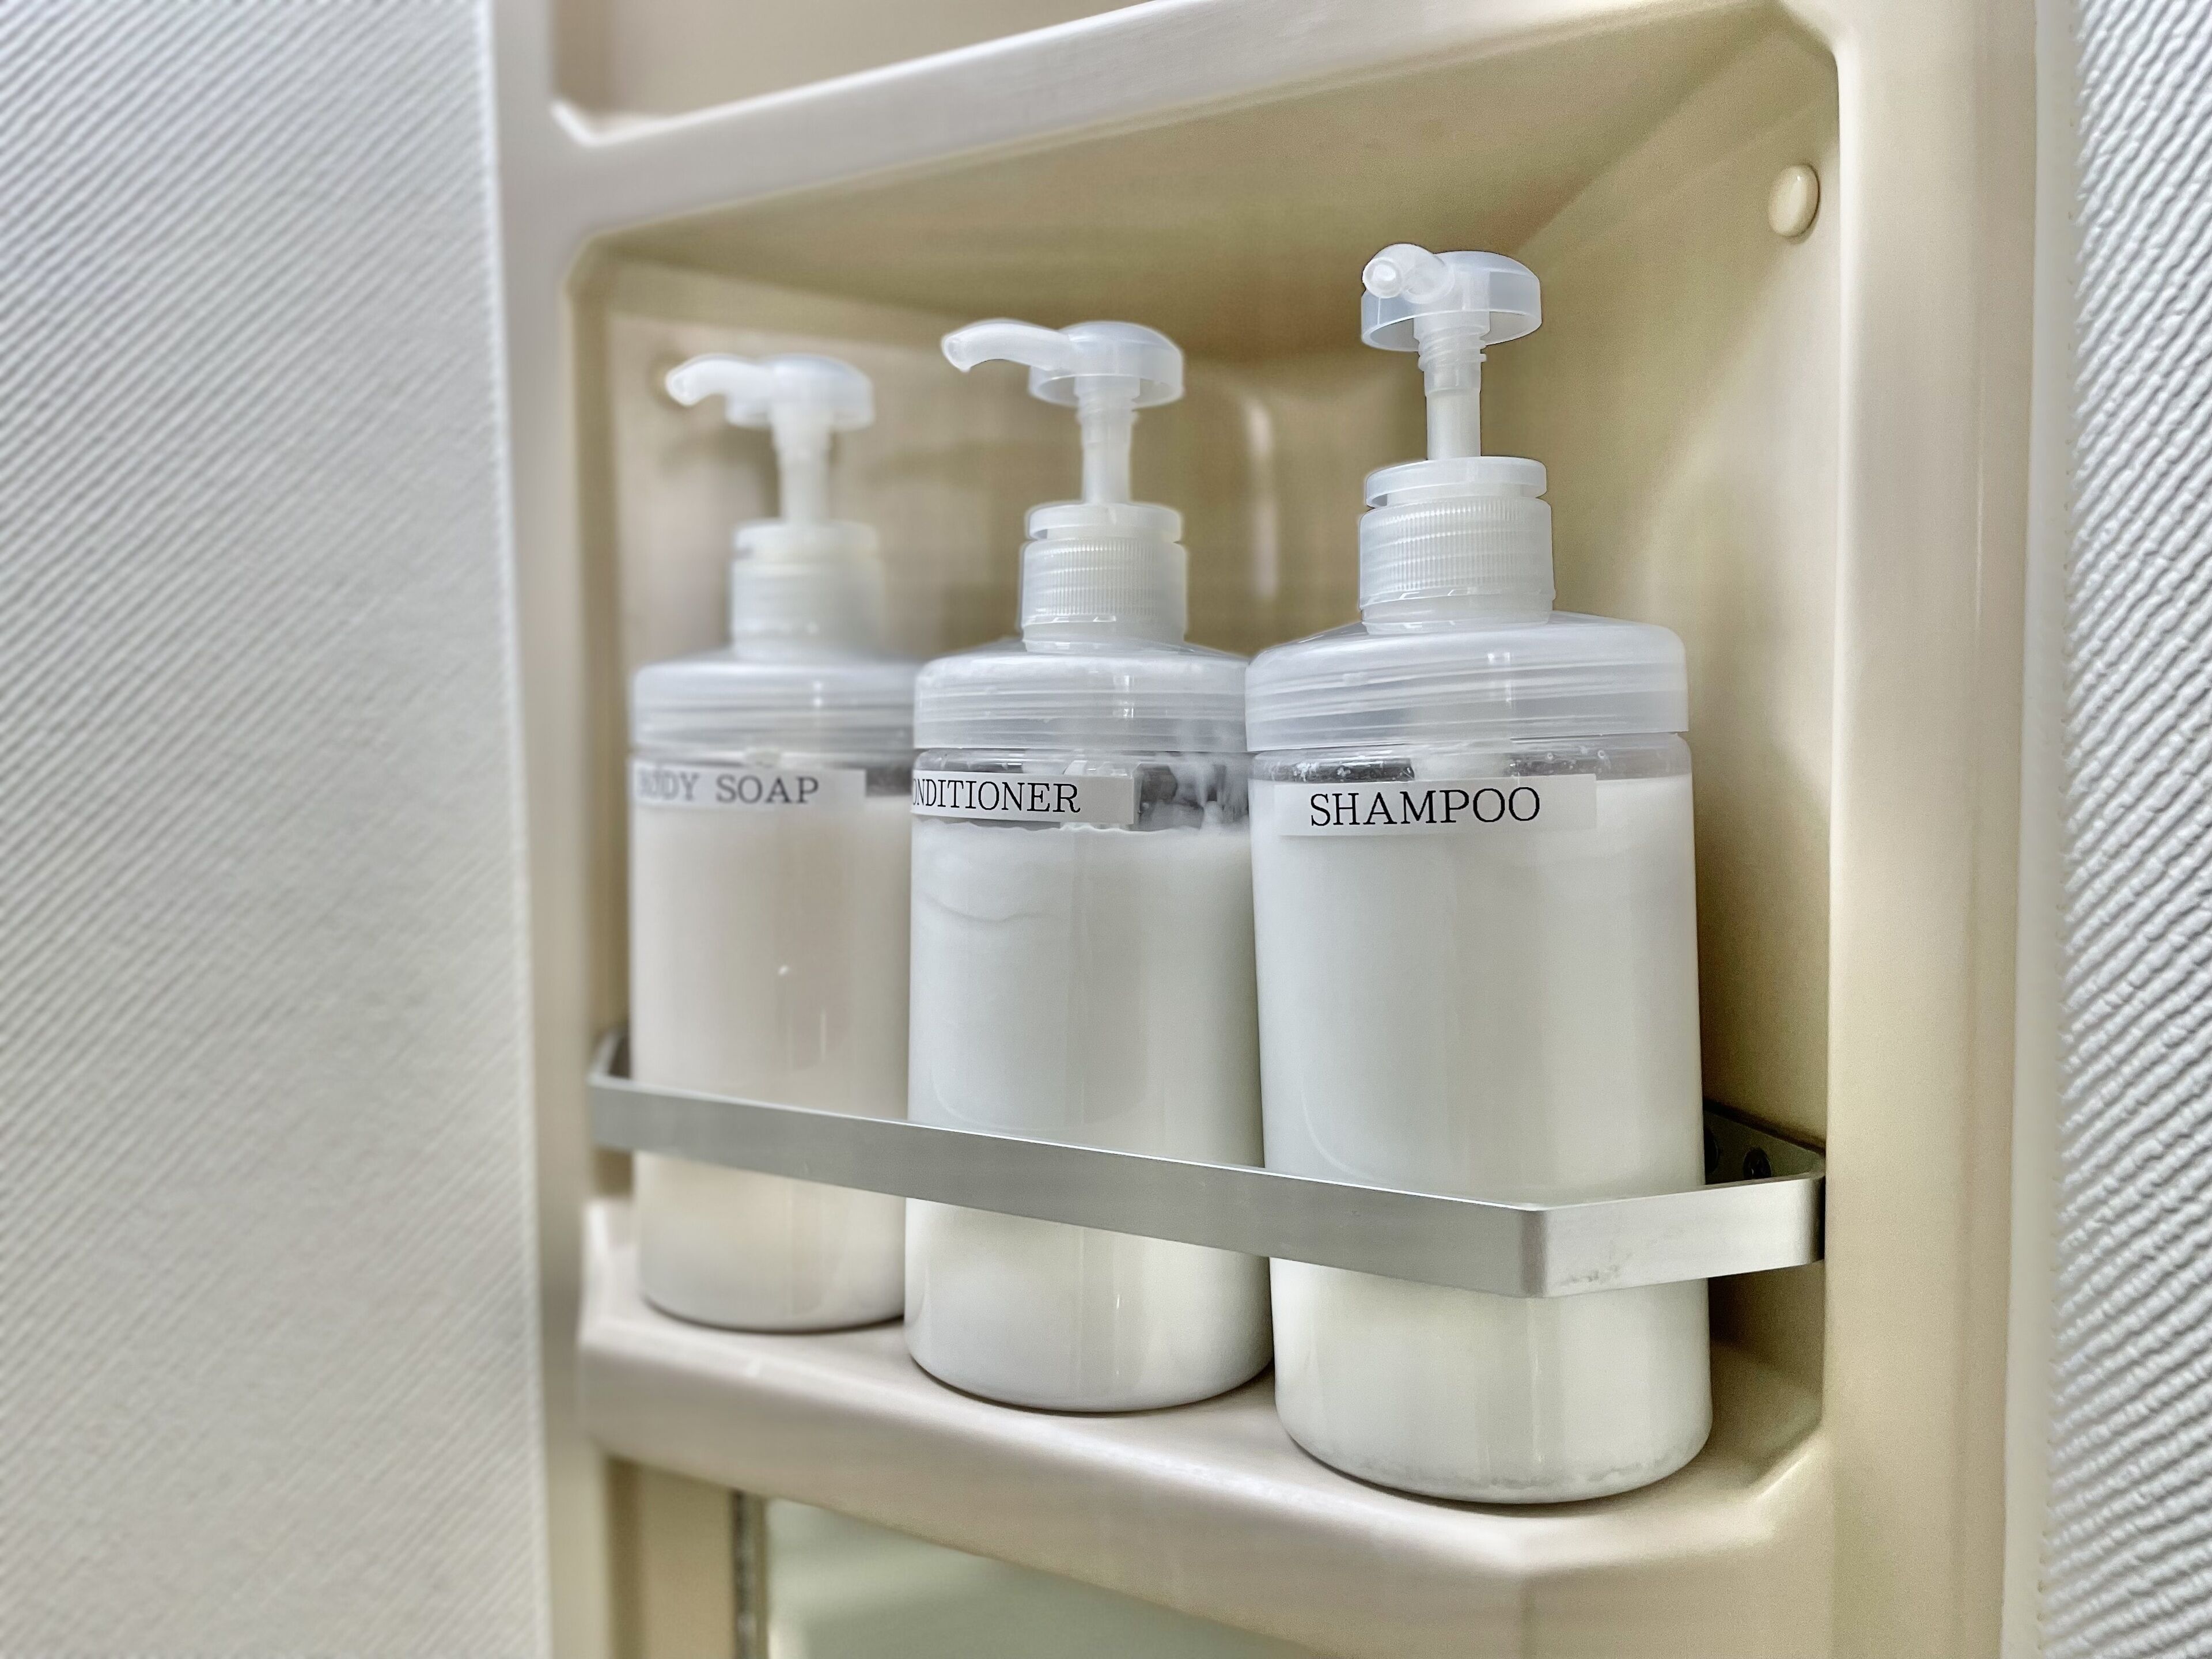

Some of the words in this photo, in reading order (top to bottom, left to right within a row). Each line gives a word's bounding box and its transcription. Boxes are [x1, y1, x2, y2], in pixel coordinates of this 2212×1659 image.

[716, 774, 819, 804] SOAP
[913, 779, 1081, 813] ONDITIONER
[1310, 787, 1540, 826] SHAMPOO
